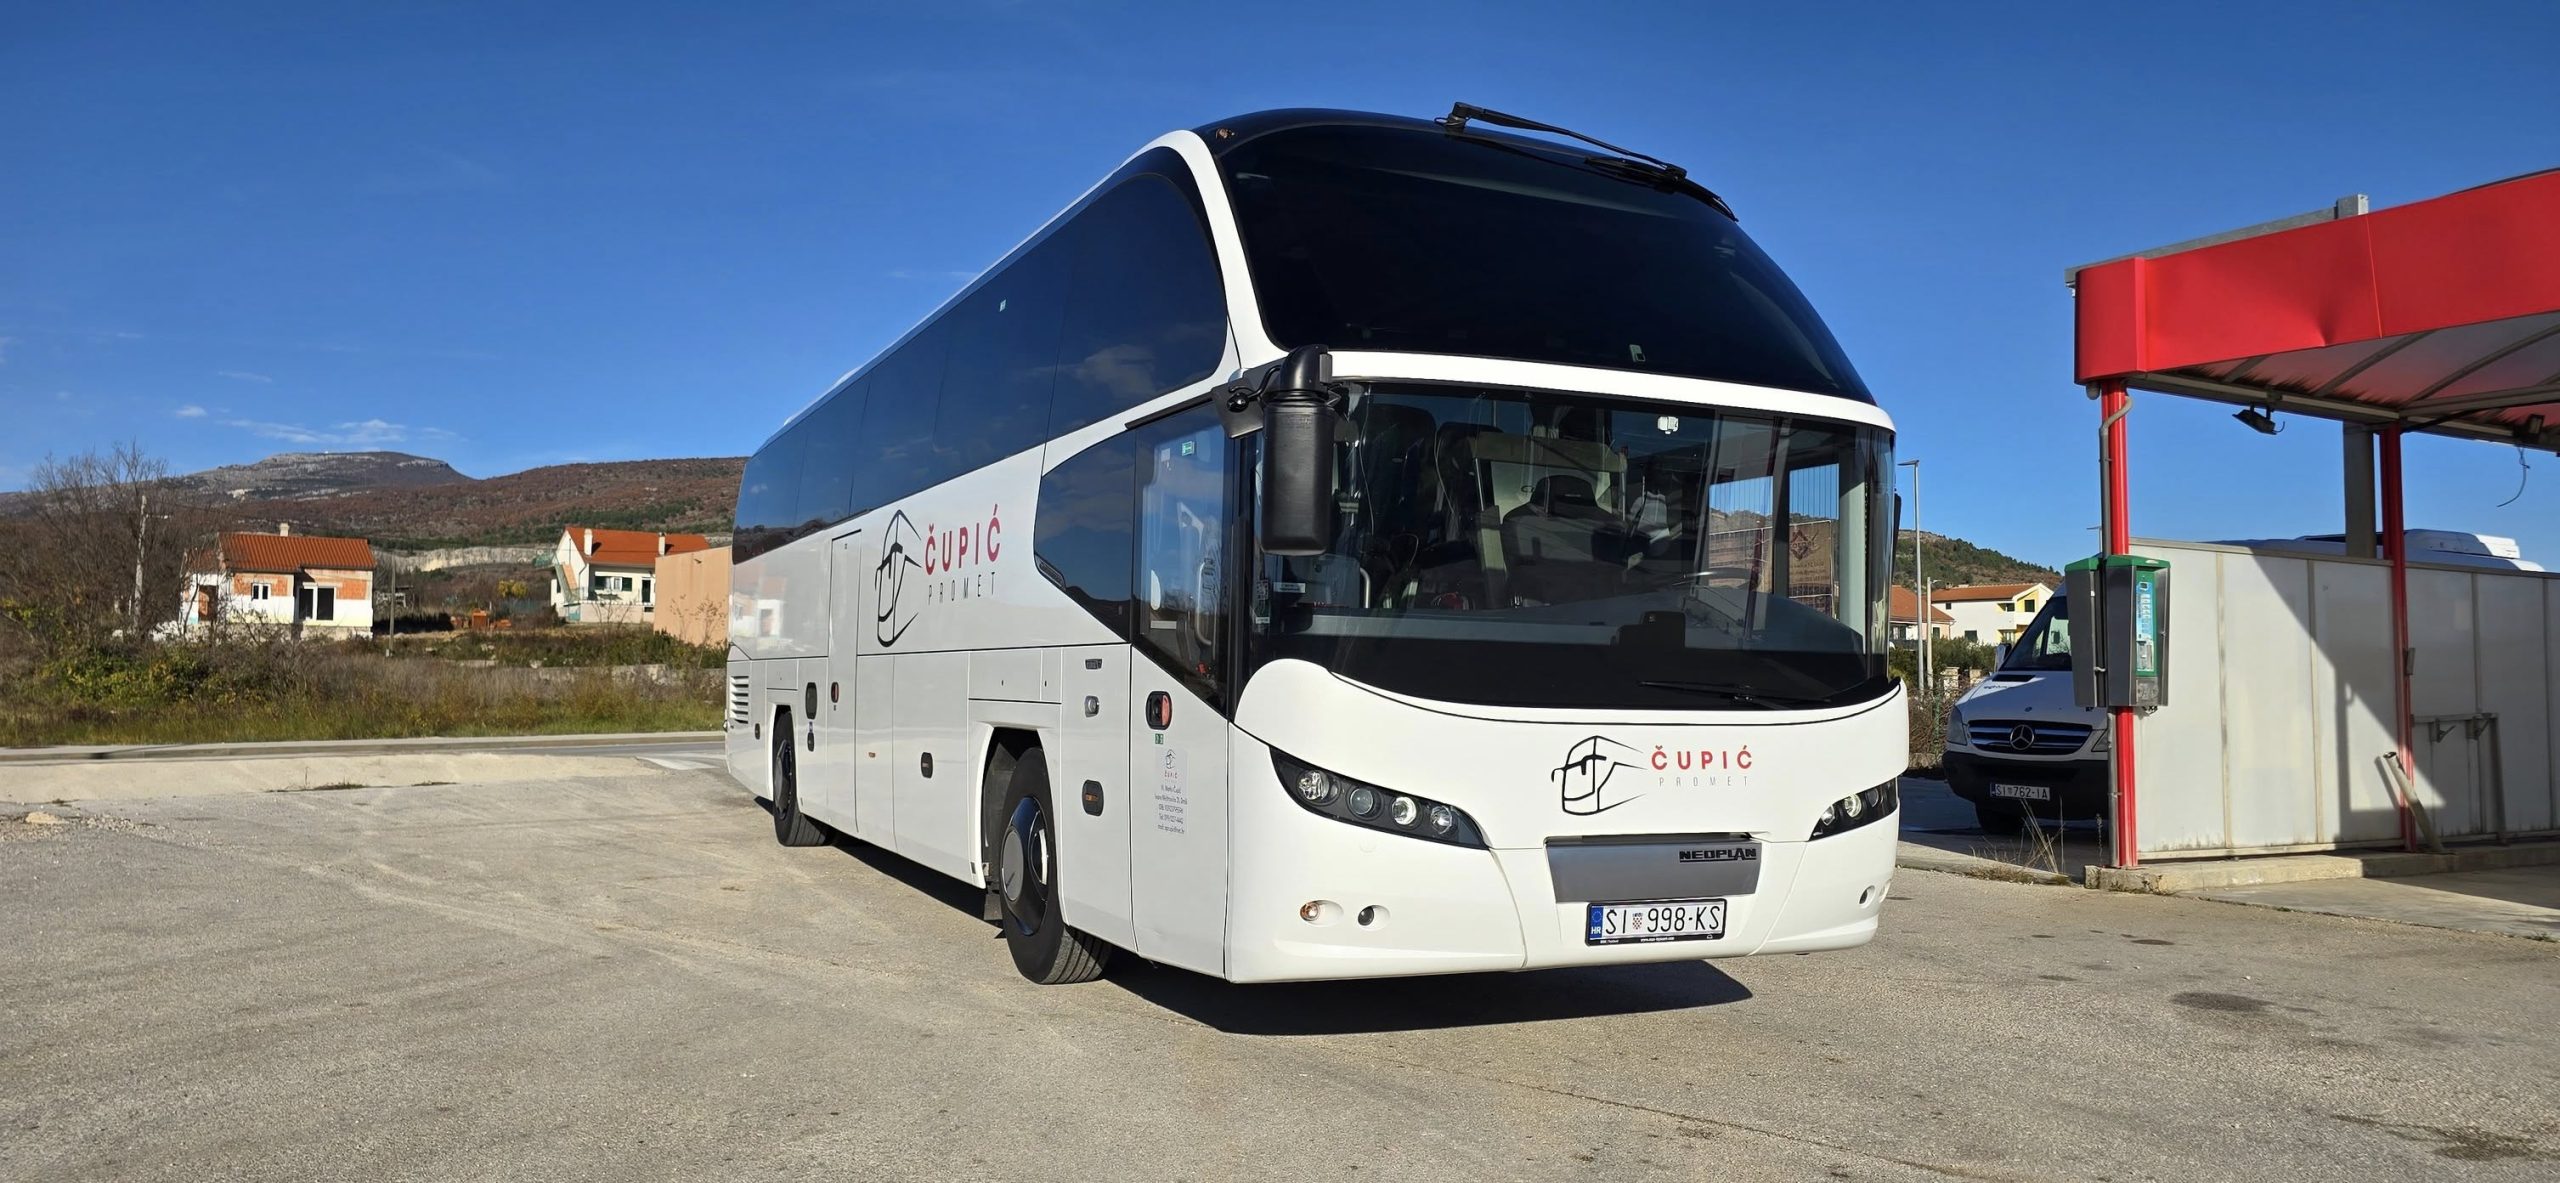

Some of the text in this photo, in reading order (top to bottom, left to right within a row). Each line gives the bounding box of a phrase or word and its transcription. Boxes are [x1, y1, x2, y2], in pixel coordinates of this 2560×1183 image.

[924, 503, 1000, 575] ČUPIĆ
[928, 572, 996, 606] PROMET
[1651, 745, 1753, 770] ČUPIĆ
[1659, 776, 1749, 787] PROMET
[1679, 848, 1757, 861] NEOPLAN
[1590, 926, 1602, 935] HR
[1647, 905, 1721, 933] 998-KS
